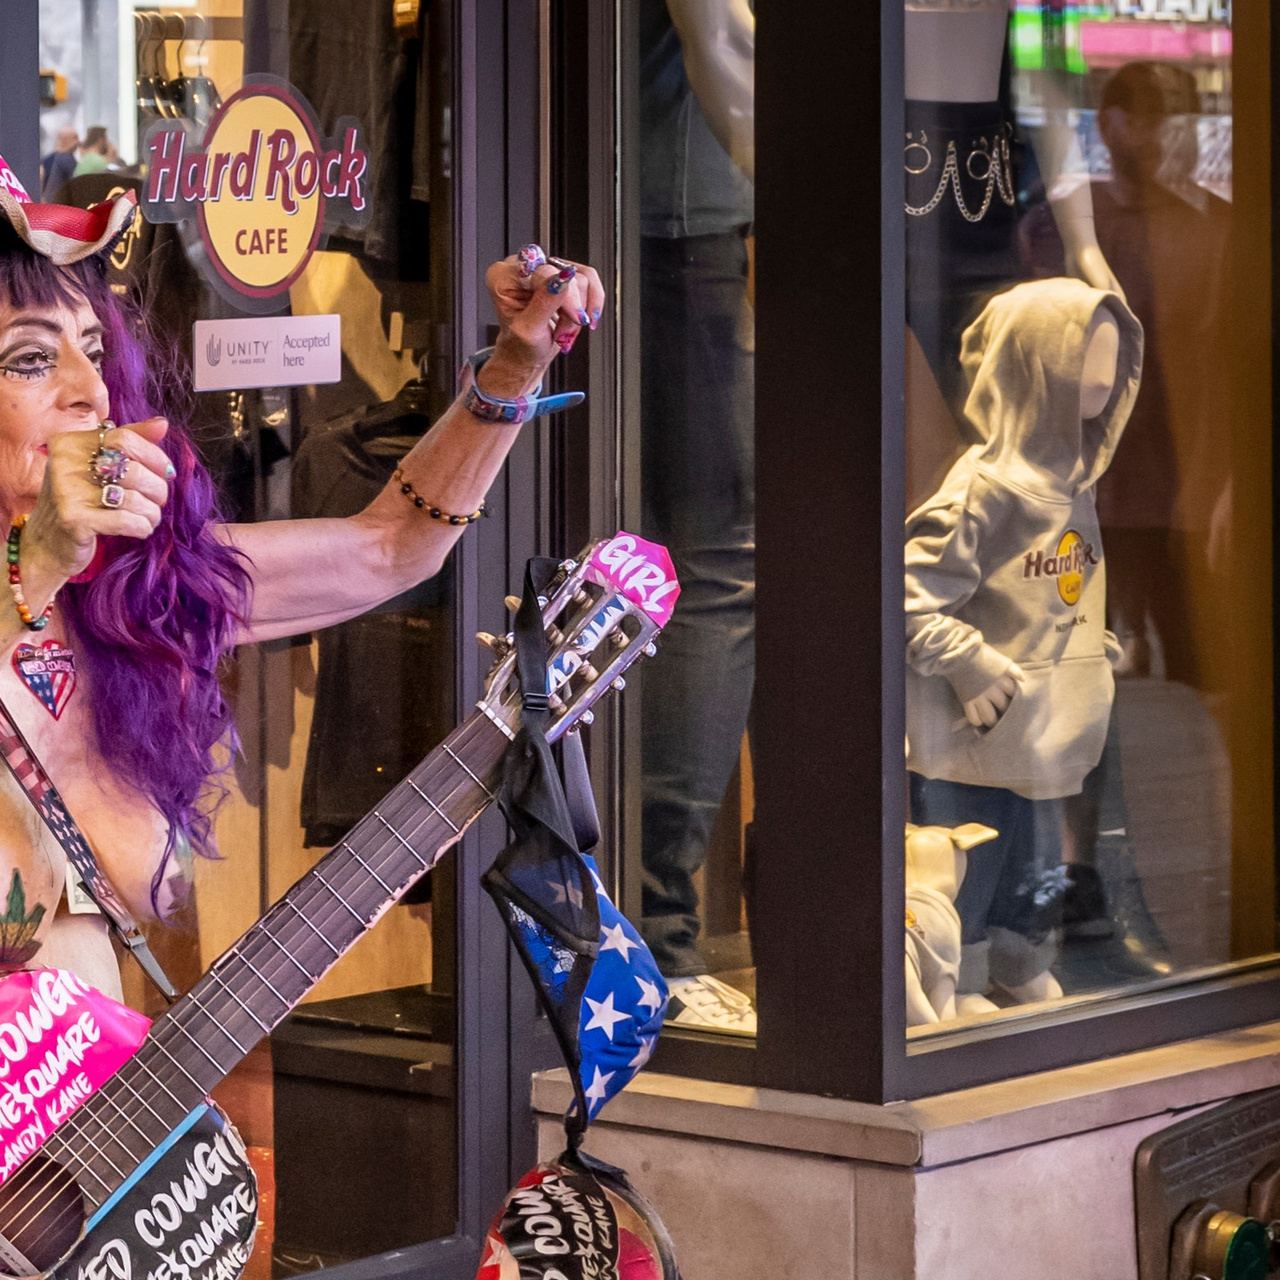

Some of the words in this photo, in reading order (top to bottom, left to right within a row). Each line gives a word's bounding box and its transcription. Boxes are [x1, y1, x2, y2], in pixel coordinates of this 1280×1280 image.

[148, 129, 263, 203] Hard
[265, 127, 367, 215] Rock
[235, 228, 288, 256] CAFE
[227, 341, 269, 357] UNITY
[282, 332, 330, 351] Accepted
[283, 352, 305, 367] here
[598, 535, 680, 614] GIRL
[45, 1072, 93, 1126] KANE
[585, 1194, 613, 1249] KANE
